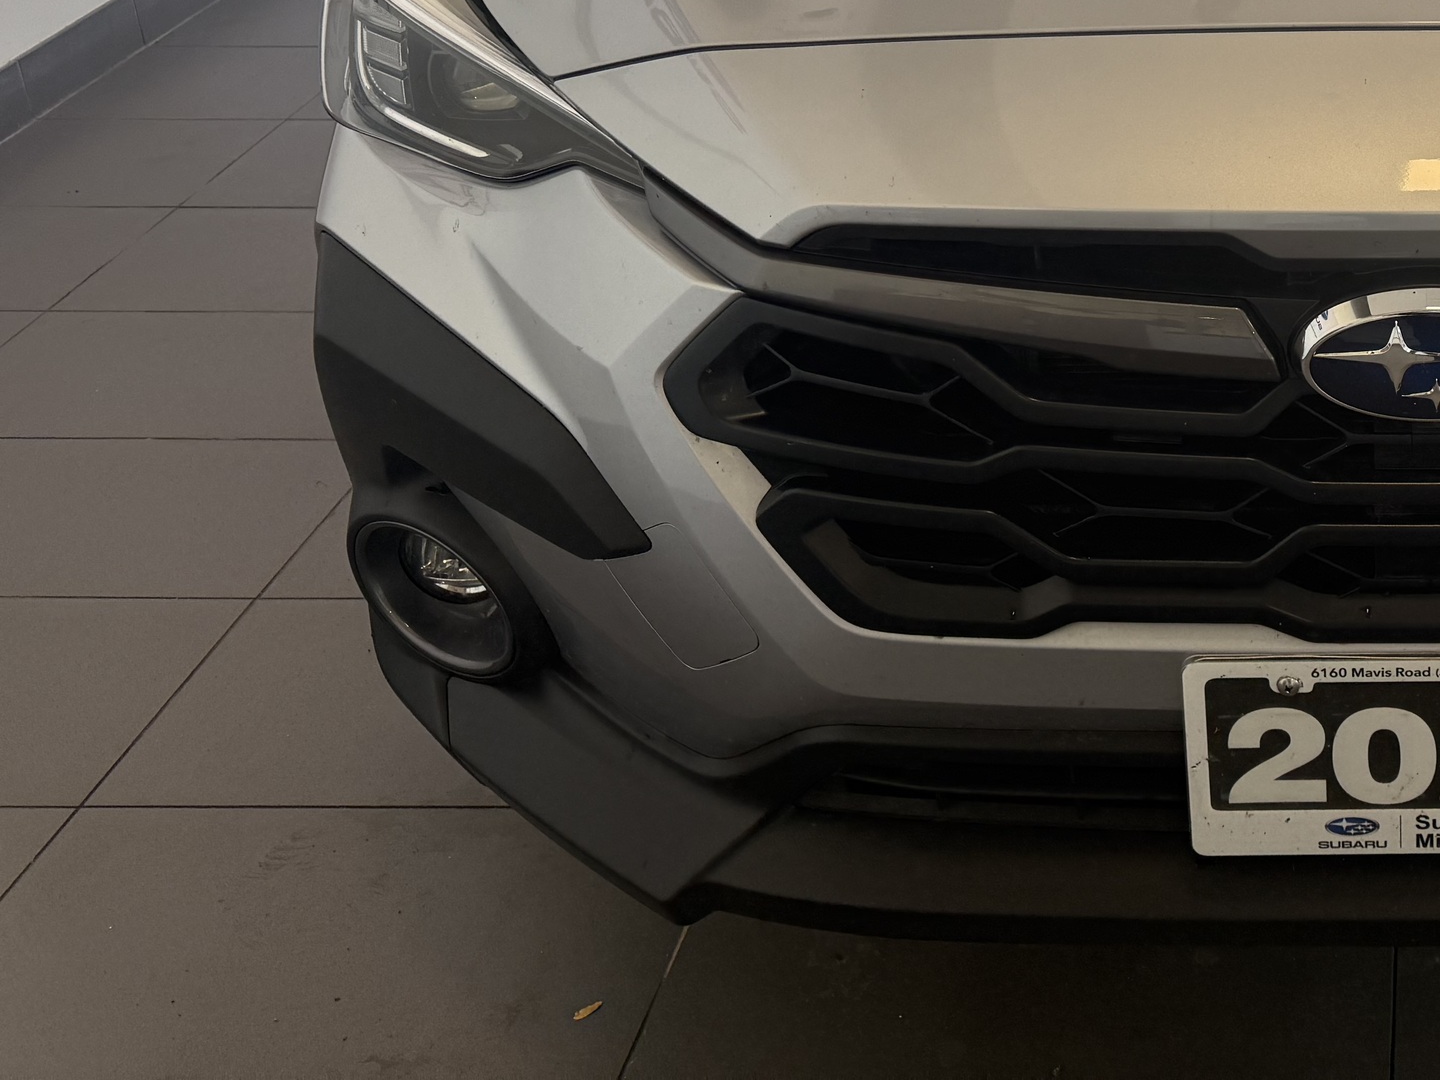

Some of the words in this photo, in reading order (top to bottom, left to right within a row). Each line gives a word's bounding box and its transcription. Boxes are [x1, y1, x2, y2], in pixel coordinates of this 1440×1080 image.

[1310, 667, 1347, 678] 6160
[1351, 667, 1391, 678] Mavis
[1395, 667, 1431, 678] Road
[1318, 840, 1388, 849] SUBARU
